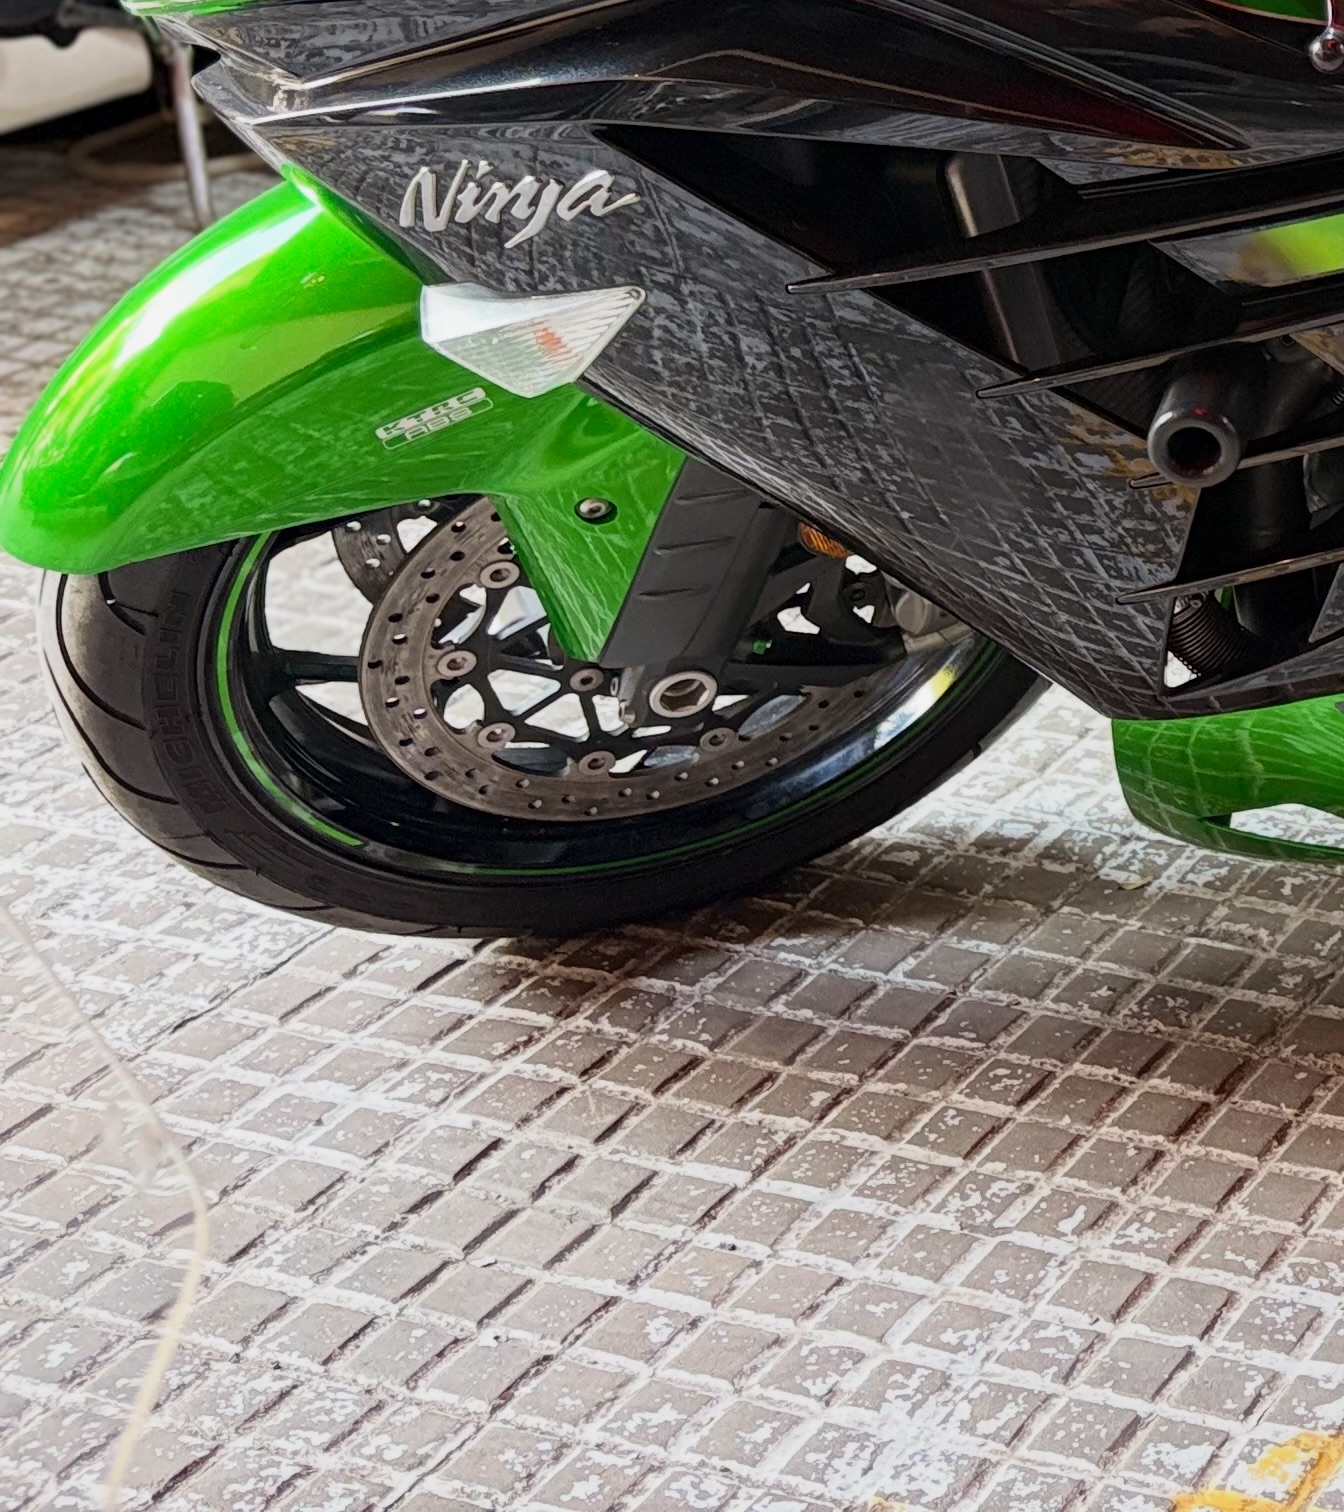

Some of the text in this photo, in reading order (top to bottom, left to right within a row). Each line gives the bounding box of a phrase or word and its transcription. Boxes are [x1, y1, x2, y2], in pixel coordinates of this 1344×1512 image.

[399, 159, 641, 249] Ninja
[382, 390, 480, 437] KTRC
[151, 589, 229, 817] MICHELIN
